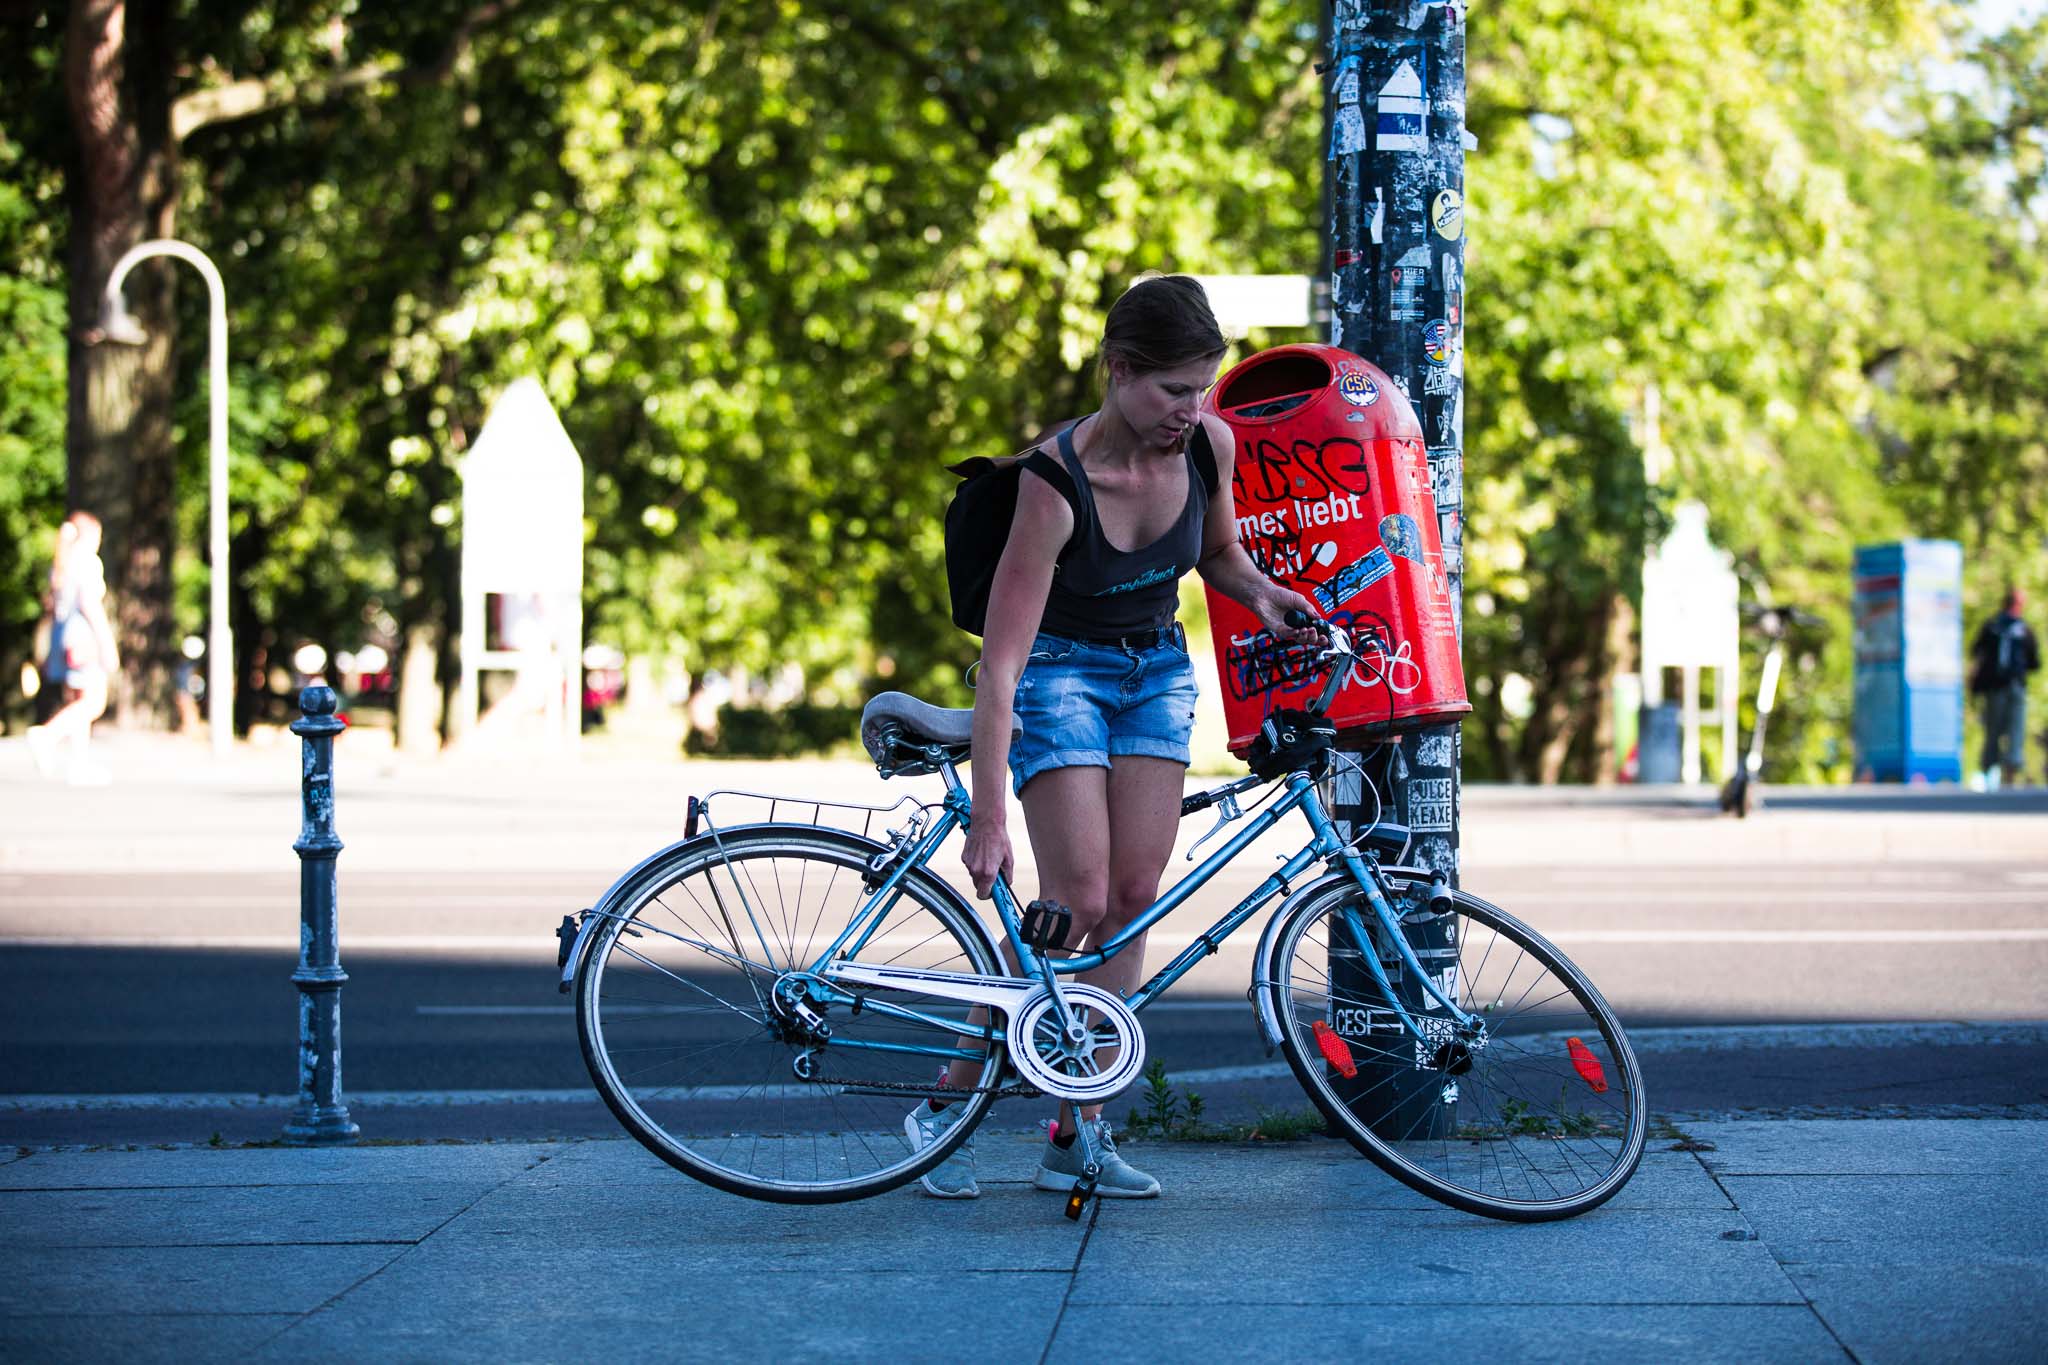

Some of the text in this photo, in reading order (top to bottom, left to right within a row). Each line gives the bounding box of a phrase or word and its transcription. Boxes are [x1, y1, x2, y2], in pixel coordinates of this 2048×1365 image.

[1346, 375, 1373, 392] CSC
[1235, 491, 1363, 541] mer liebt
